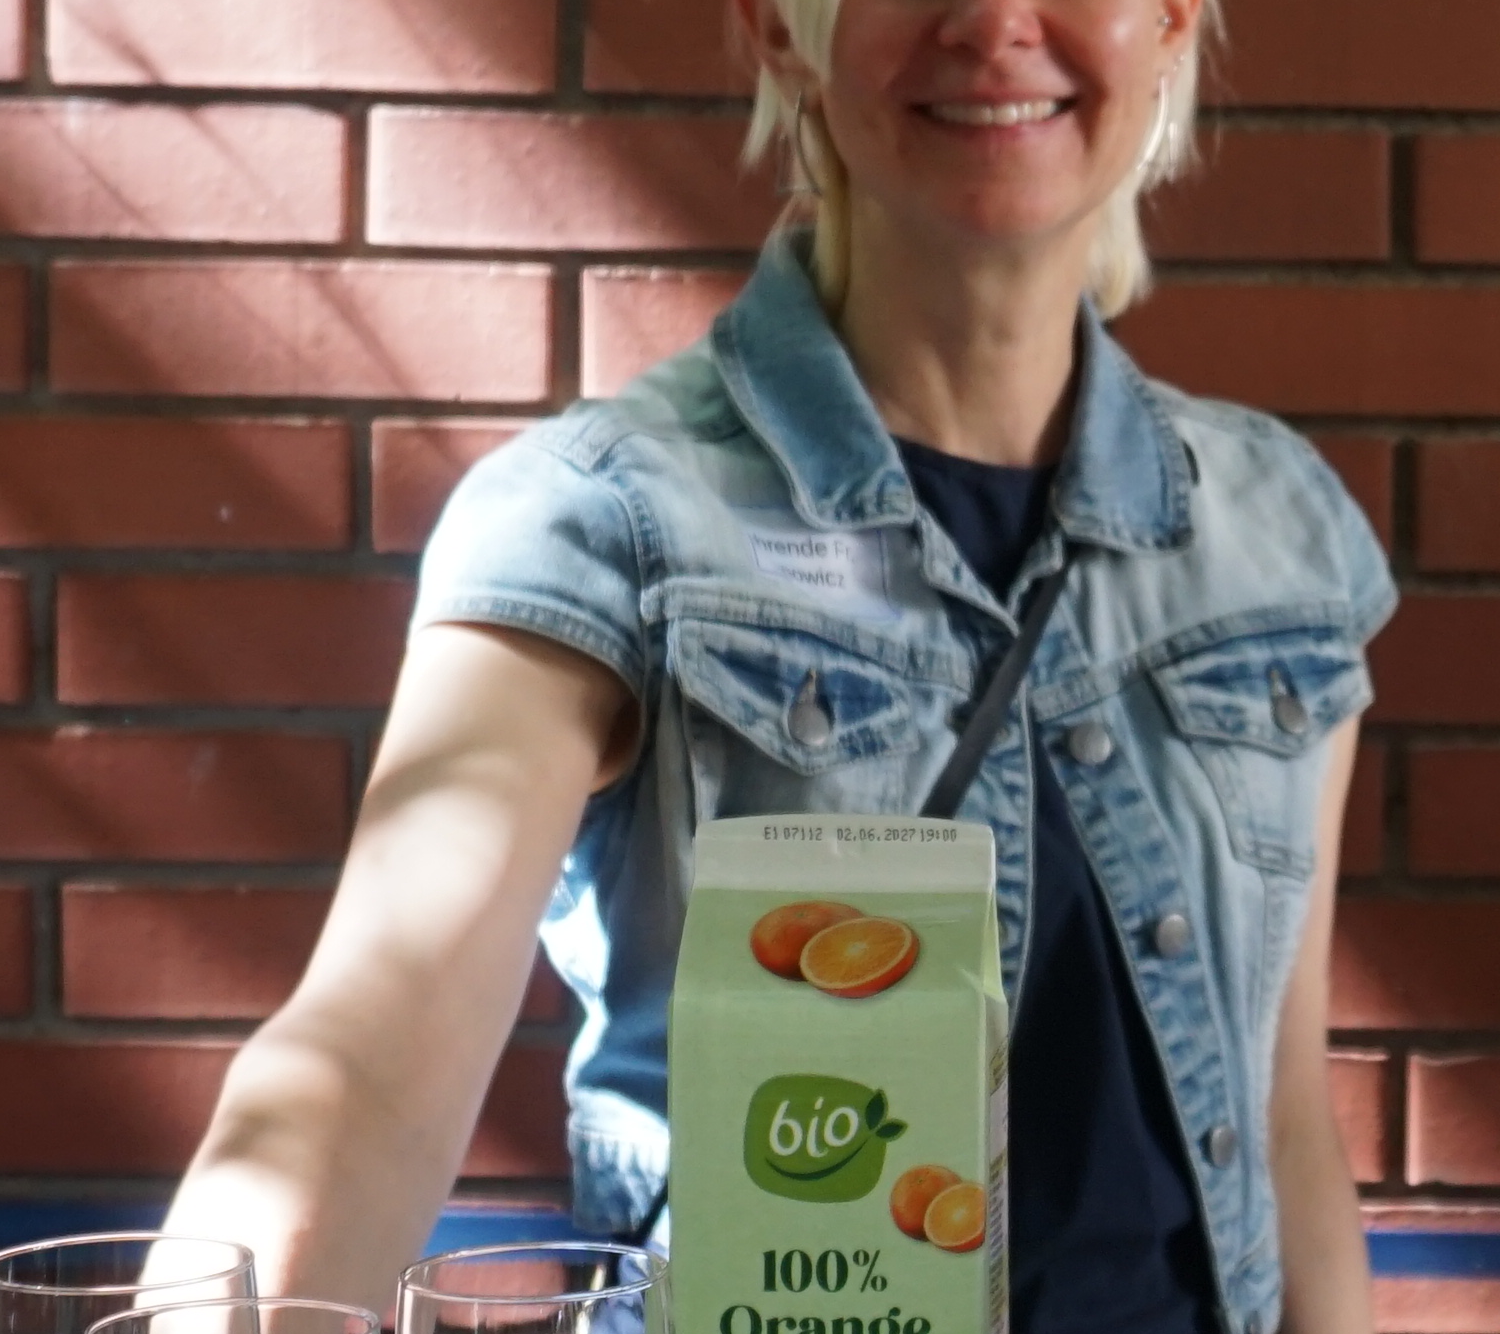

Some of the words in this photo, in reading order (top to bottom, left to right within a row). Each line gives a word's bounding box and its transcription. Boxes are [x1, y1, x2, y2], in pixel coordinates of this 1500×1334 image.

[837, 827, 916, 842] 02.06.2027
[920, 828, 957, 842] 19:00
[768, 1097, 859, 1158] bio
[762, 1248, 888, 1293] 100%
